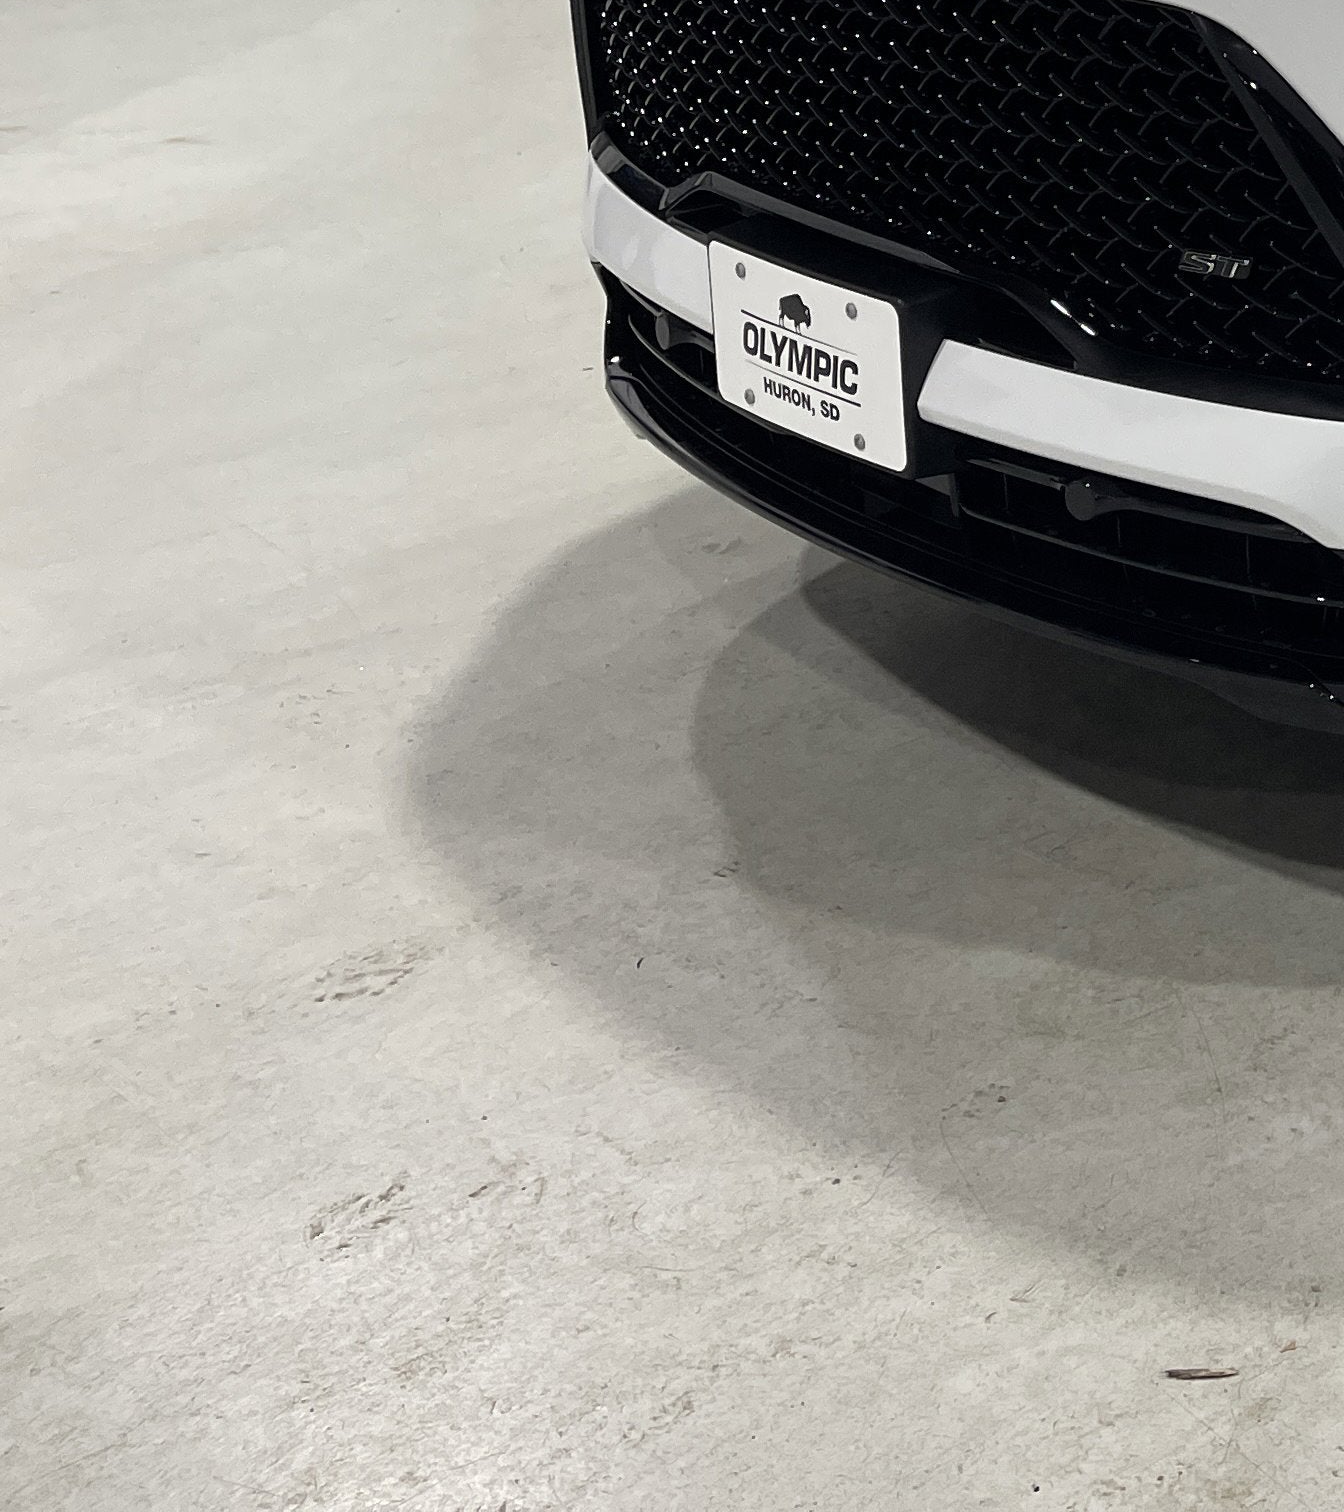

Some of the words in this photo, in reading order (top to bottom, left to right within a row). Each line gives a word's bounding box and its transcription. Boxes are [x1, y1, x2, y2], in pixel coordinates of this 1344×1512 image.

[1179, 251, 1250, 278] ST
[743, 321, 859, 396] OLYMPIC
[763, 376, 816, 417] HURON,
[819, 399, 840, 422] SD
